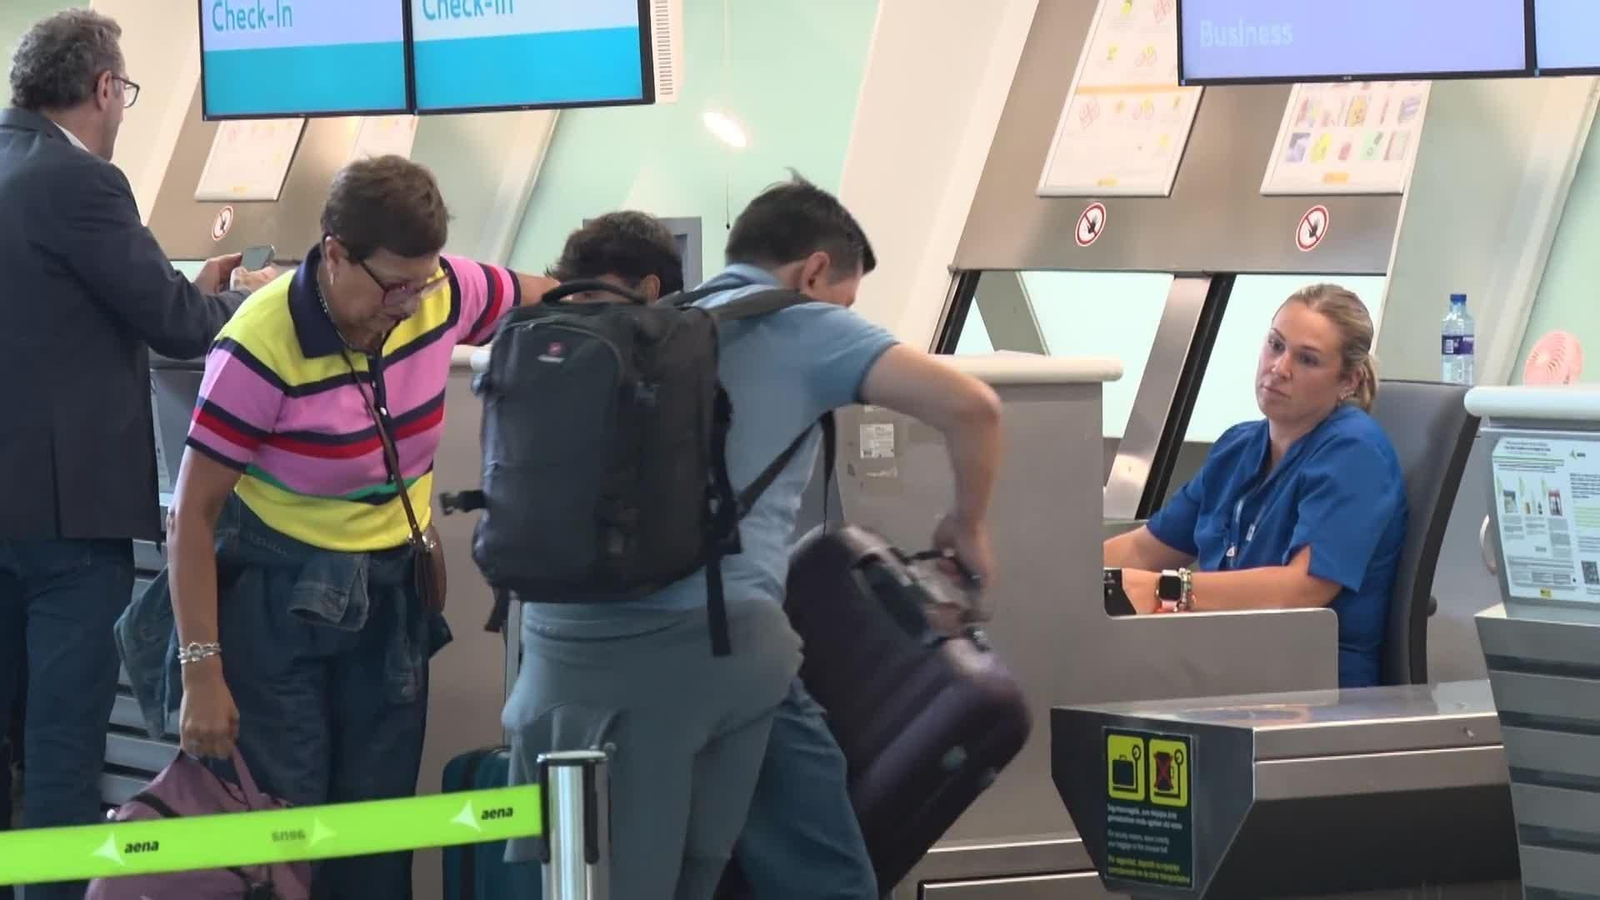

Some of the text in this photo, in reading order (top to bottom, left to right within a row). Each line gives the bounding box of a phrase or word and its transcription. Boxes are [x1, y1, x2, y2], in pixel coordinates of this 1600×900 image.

[212, 0, 293, 32] Check-In
[1199, 18, 1294, 48] Business
[481, 806, 514, 820] aena
[124, 840, 160, 853] aena
